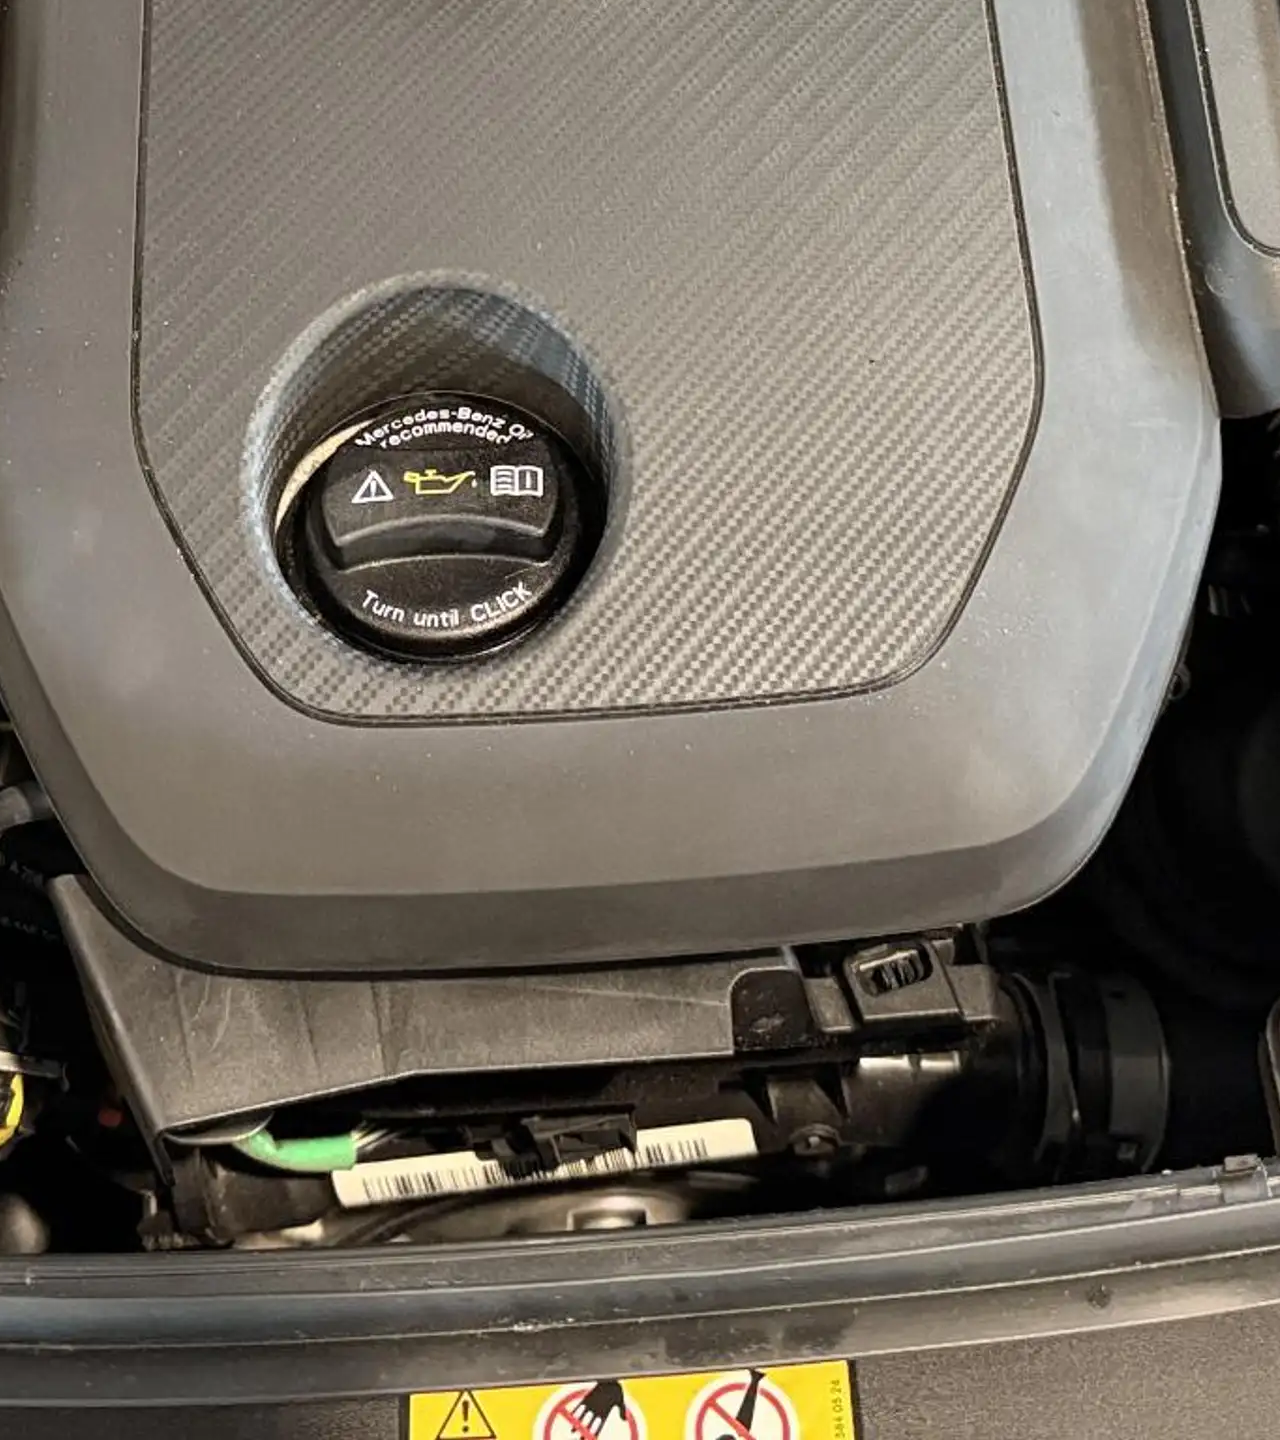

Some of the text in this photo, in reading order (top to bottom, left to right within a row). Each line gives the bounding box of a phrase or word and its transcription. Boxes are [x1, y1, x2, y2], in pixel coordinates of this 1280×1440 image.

[354, 406, 507, 446] Mercedes-Benz
[379, 421, 513, 449] recommended
[361, 580, 534, 628] Turn until CLICK
